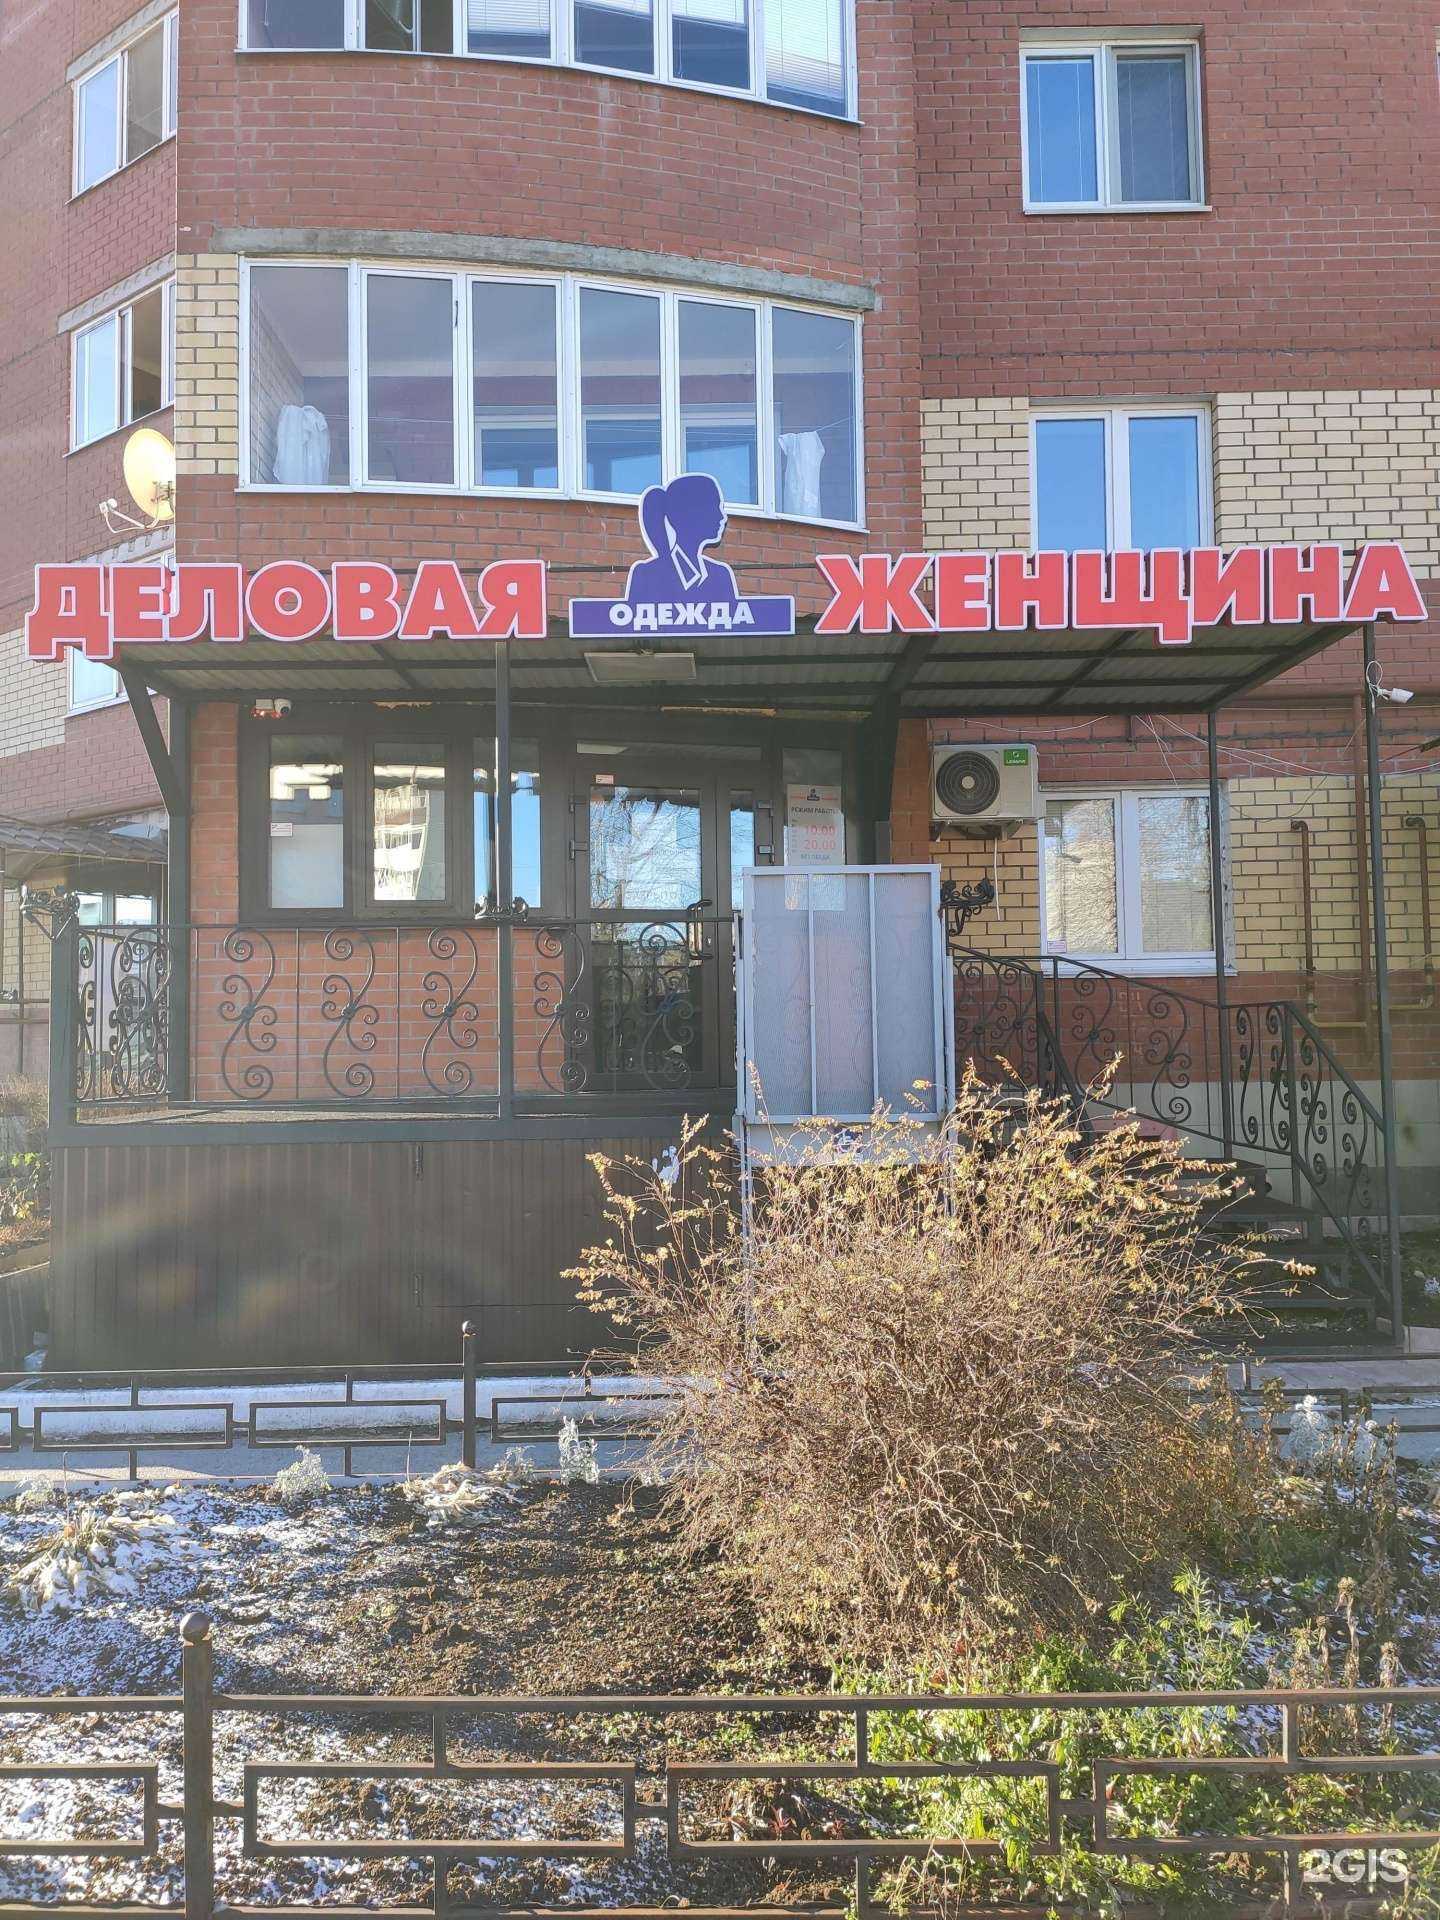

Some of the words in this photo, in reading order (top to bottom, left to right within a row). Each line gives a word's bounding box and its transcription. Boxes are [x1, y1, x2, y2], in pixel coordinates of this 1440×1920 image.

[25, 560, 547, 659] ДЕЛОВАЯ
[814, 541, 1428, 644] ЖЕНЩИНА
[609, 602, 755, 631] ОДЕЖДА
